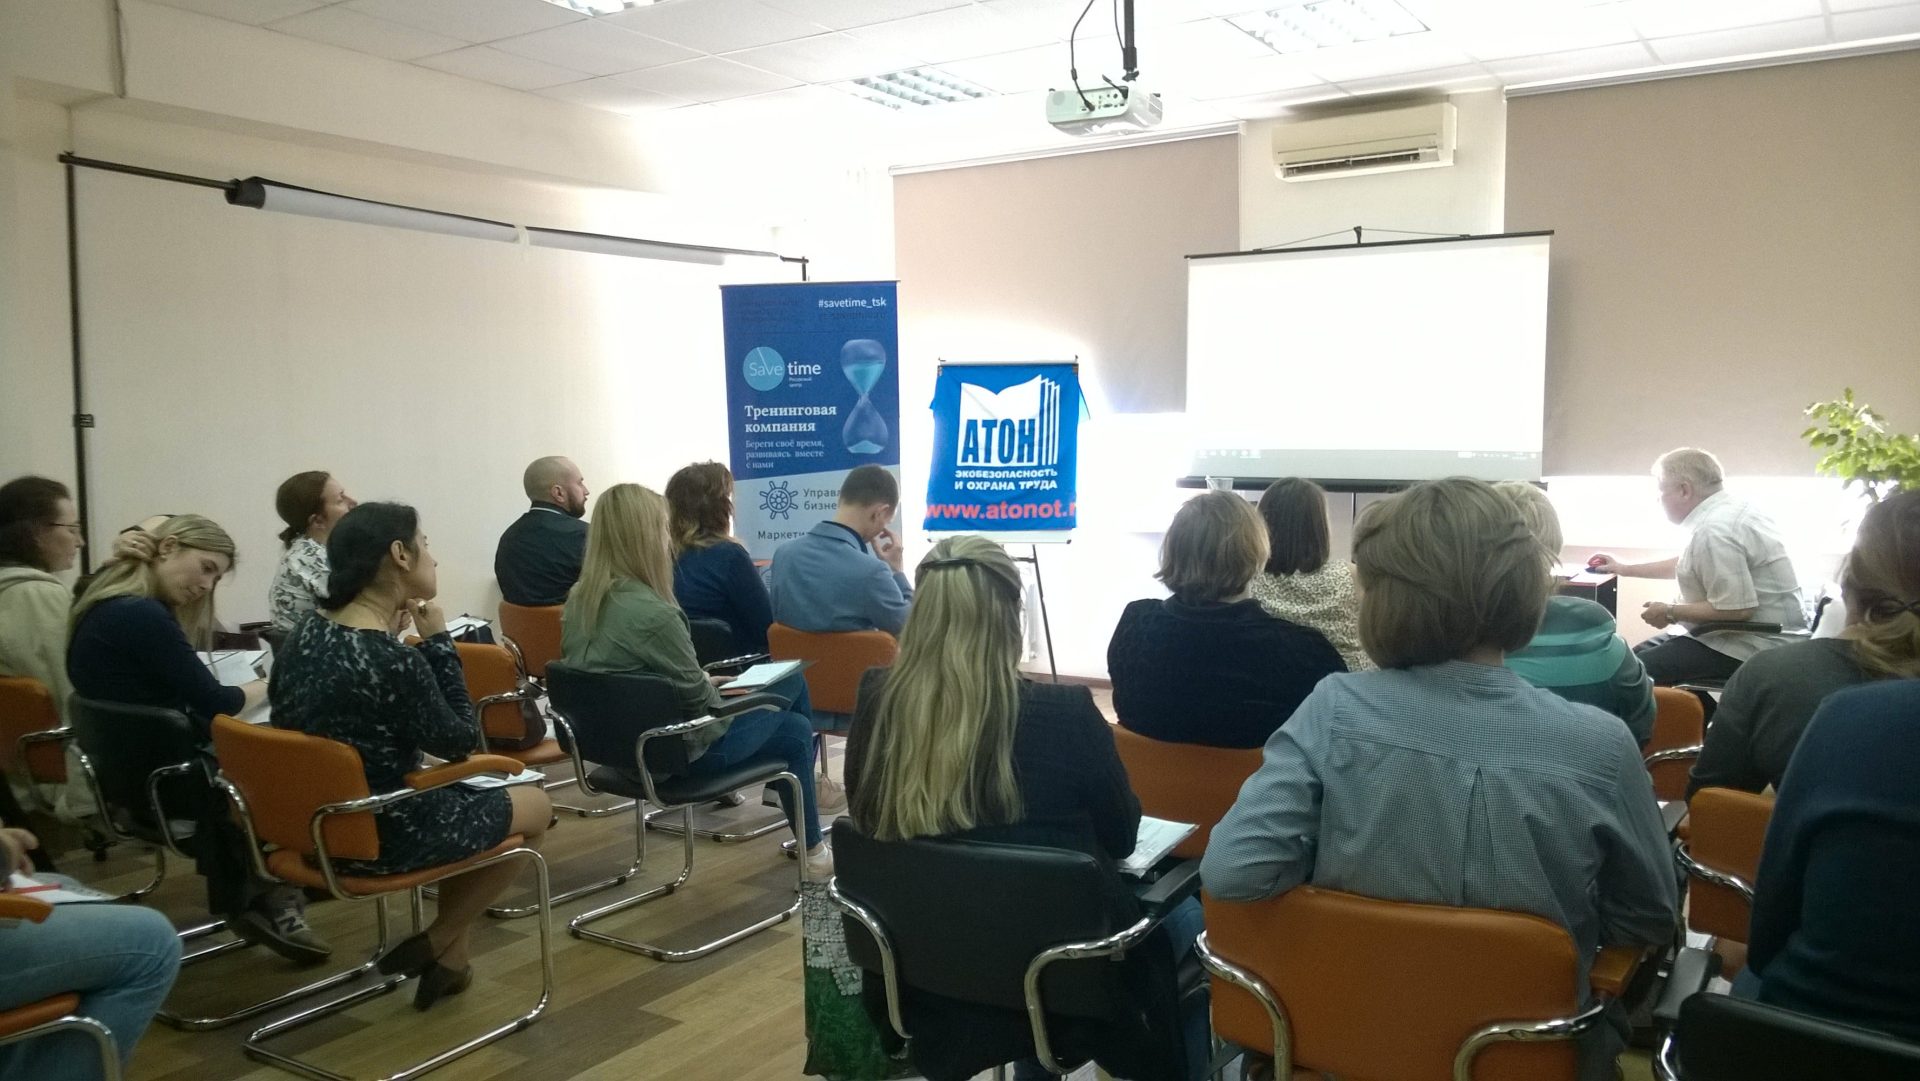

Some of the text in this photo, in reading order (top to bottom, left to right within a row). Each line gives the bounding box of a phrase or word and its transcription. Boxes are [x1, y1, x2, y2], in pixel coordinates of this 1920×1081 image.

[818, 297, 887, 309] #savetime_tsk
[749, 361, 822, 377] Save time
[744, 405, 837, 420] Тренинговая
[745, 422, 816, 433] компания
[745, 440, 774, 450] Береги
[961, 418, 1036, 465] АТОН
[795, 450, 825, 458] вместе
[955, 468, 1058, 479] ЭКОБЕЗОПАСНОСТЬ
[954, 479, 1058, 491] И ОХРАНА ТРУДА
